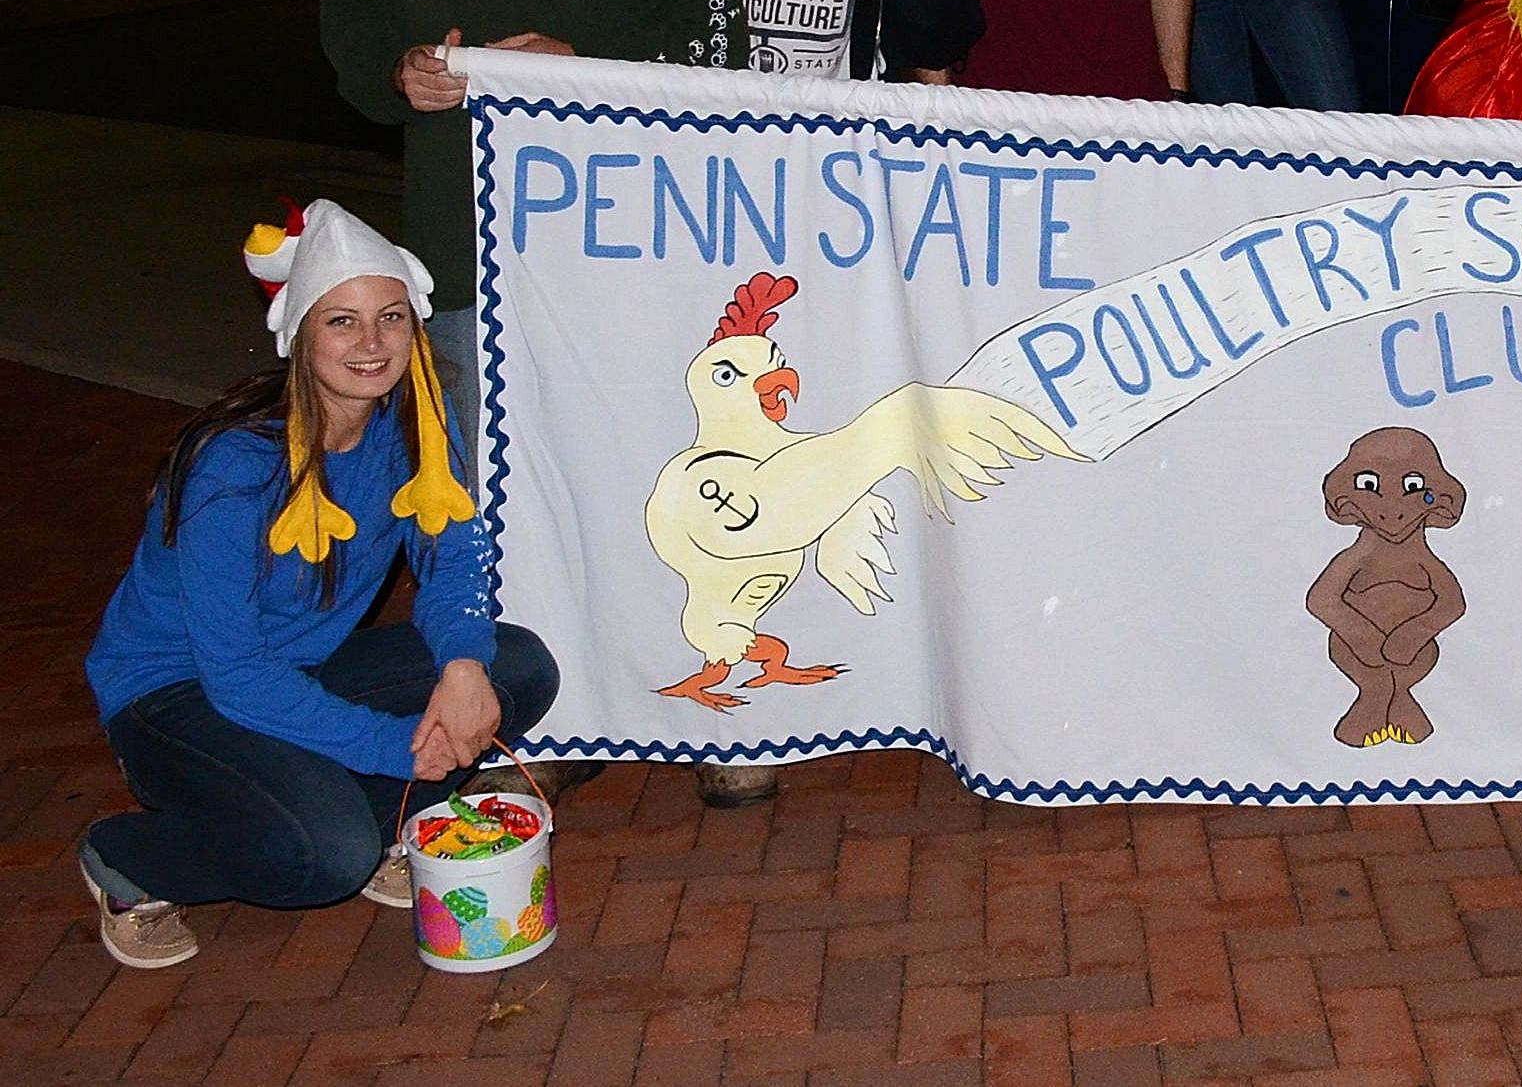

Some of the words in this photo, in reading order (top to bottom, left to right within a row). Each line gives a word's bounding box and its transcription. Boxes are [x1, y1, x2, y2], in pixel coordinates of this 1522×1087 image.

[512, 145, 786, 266] PENN
[818, 150, 1097, 290] STATE
[1017, 196, 1410, 430] POULTRY
